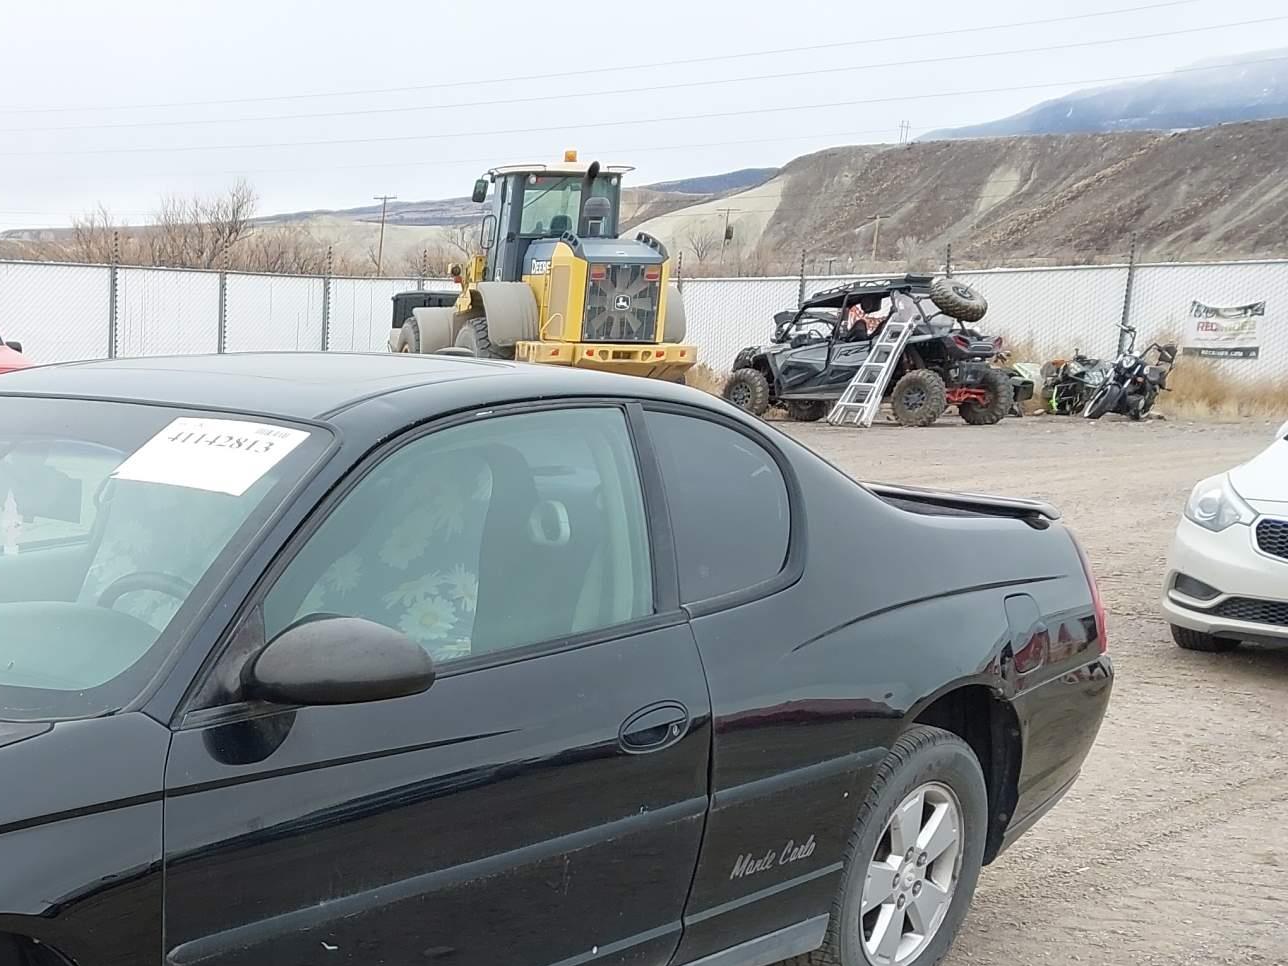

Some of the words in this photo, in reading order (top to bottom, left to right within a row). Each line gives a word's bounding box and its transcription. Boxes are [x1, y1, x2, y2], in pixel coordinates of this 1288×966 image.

[531, 258, 552, 275] DEERE
[168, 431, 275, 453] 41142813
[729, 849, 776, 879] Monte
[779, 834, 816, 864] Carlo
